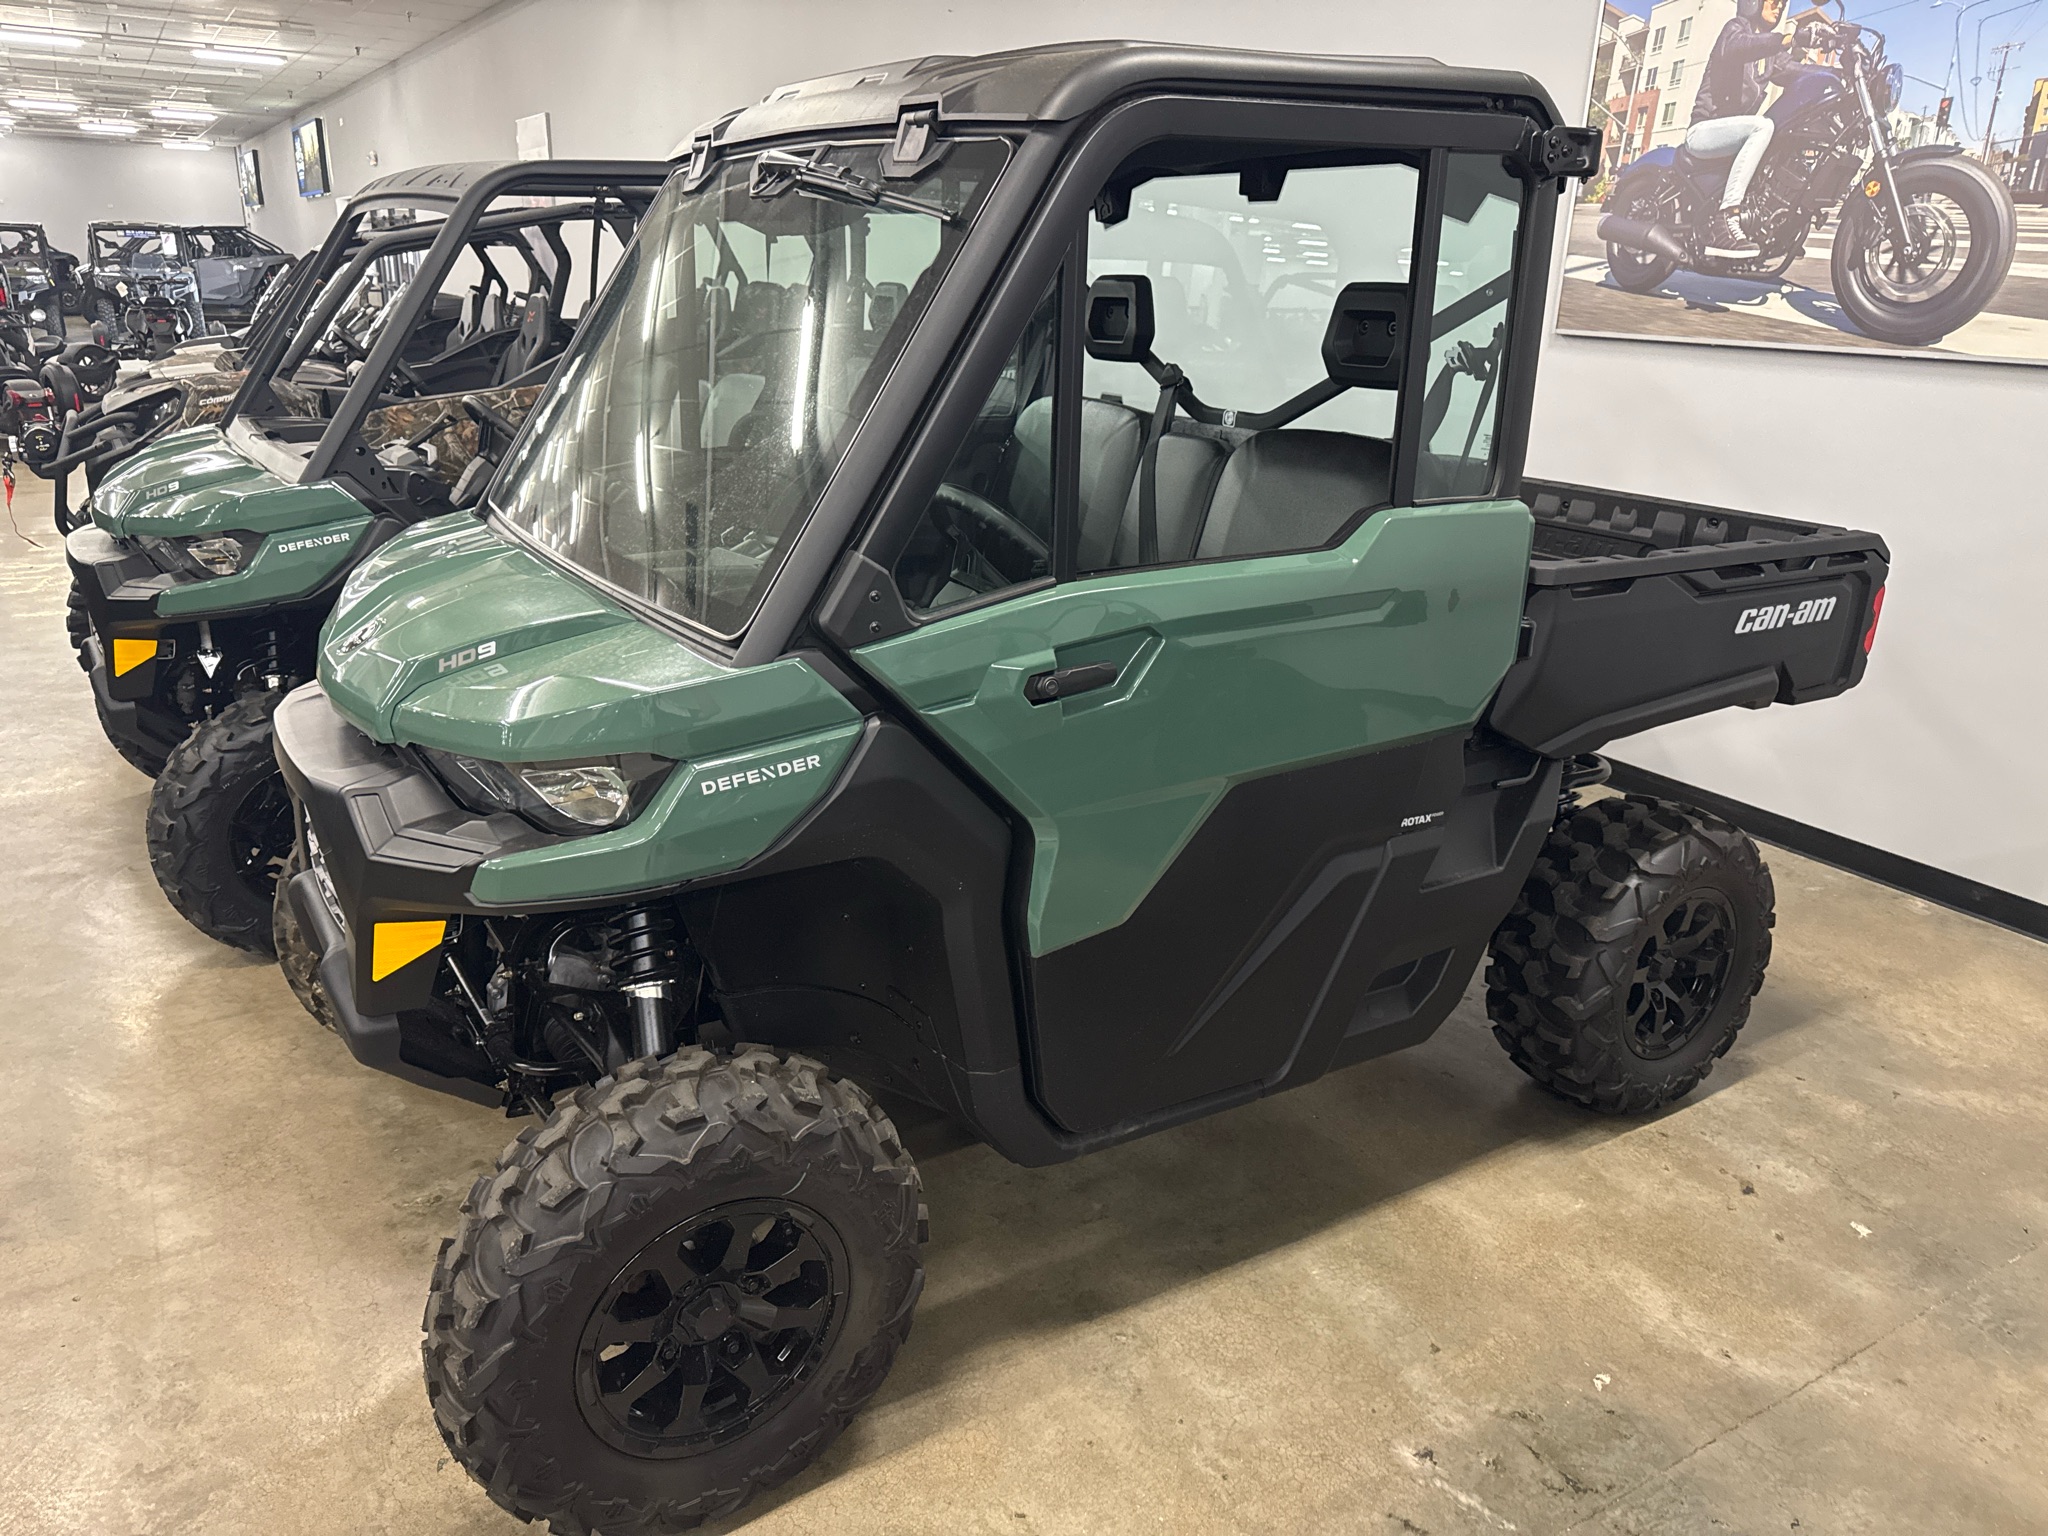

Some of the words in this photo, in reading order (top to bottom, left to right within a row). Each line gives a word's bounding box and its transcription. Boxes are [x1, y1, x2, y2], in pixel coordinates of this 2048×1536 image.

[146, 481, 179, 500] HD9
[278, 532, 350, 553] DEFENDER
[1735, 596, 1837, 634] can-am
[439, 641, 496, 673] HD9
[701, 755, 821, 795] DEFENDER
[1400, 814, 1432, 828] ROTAX
